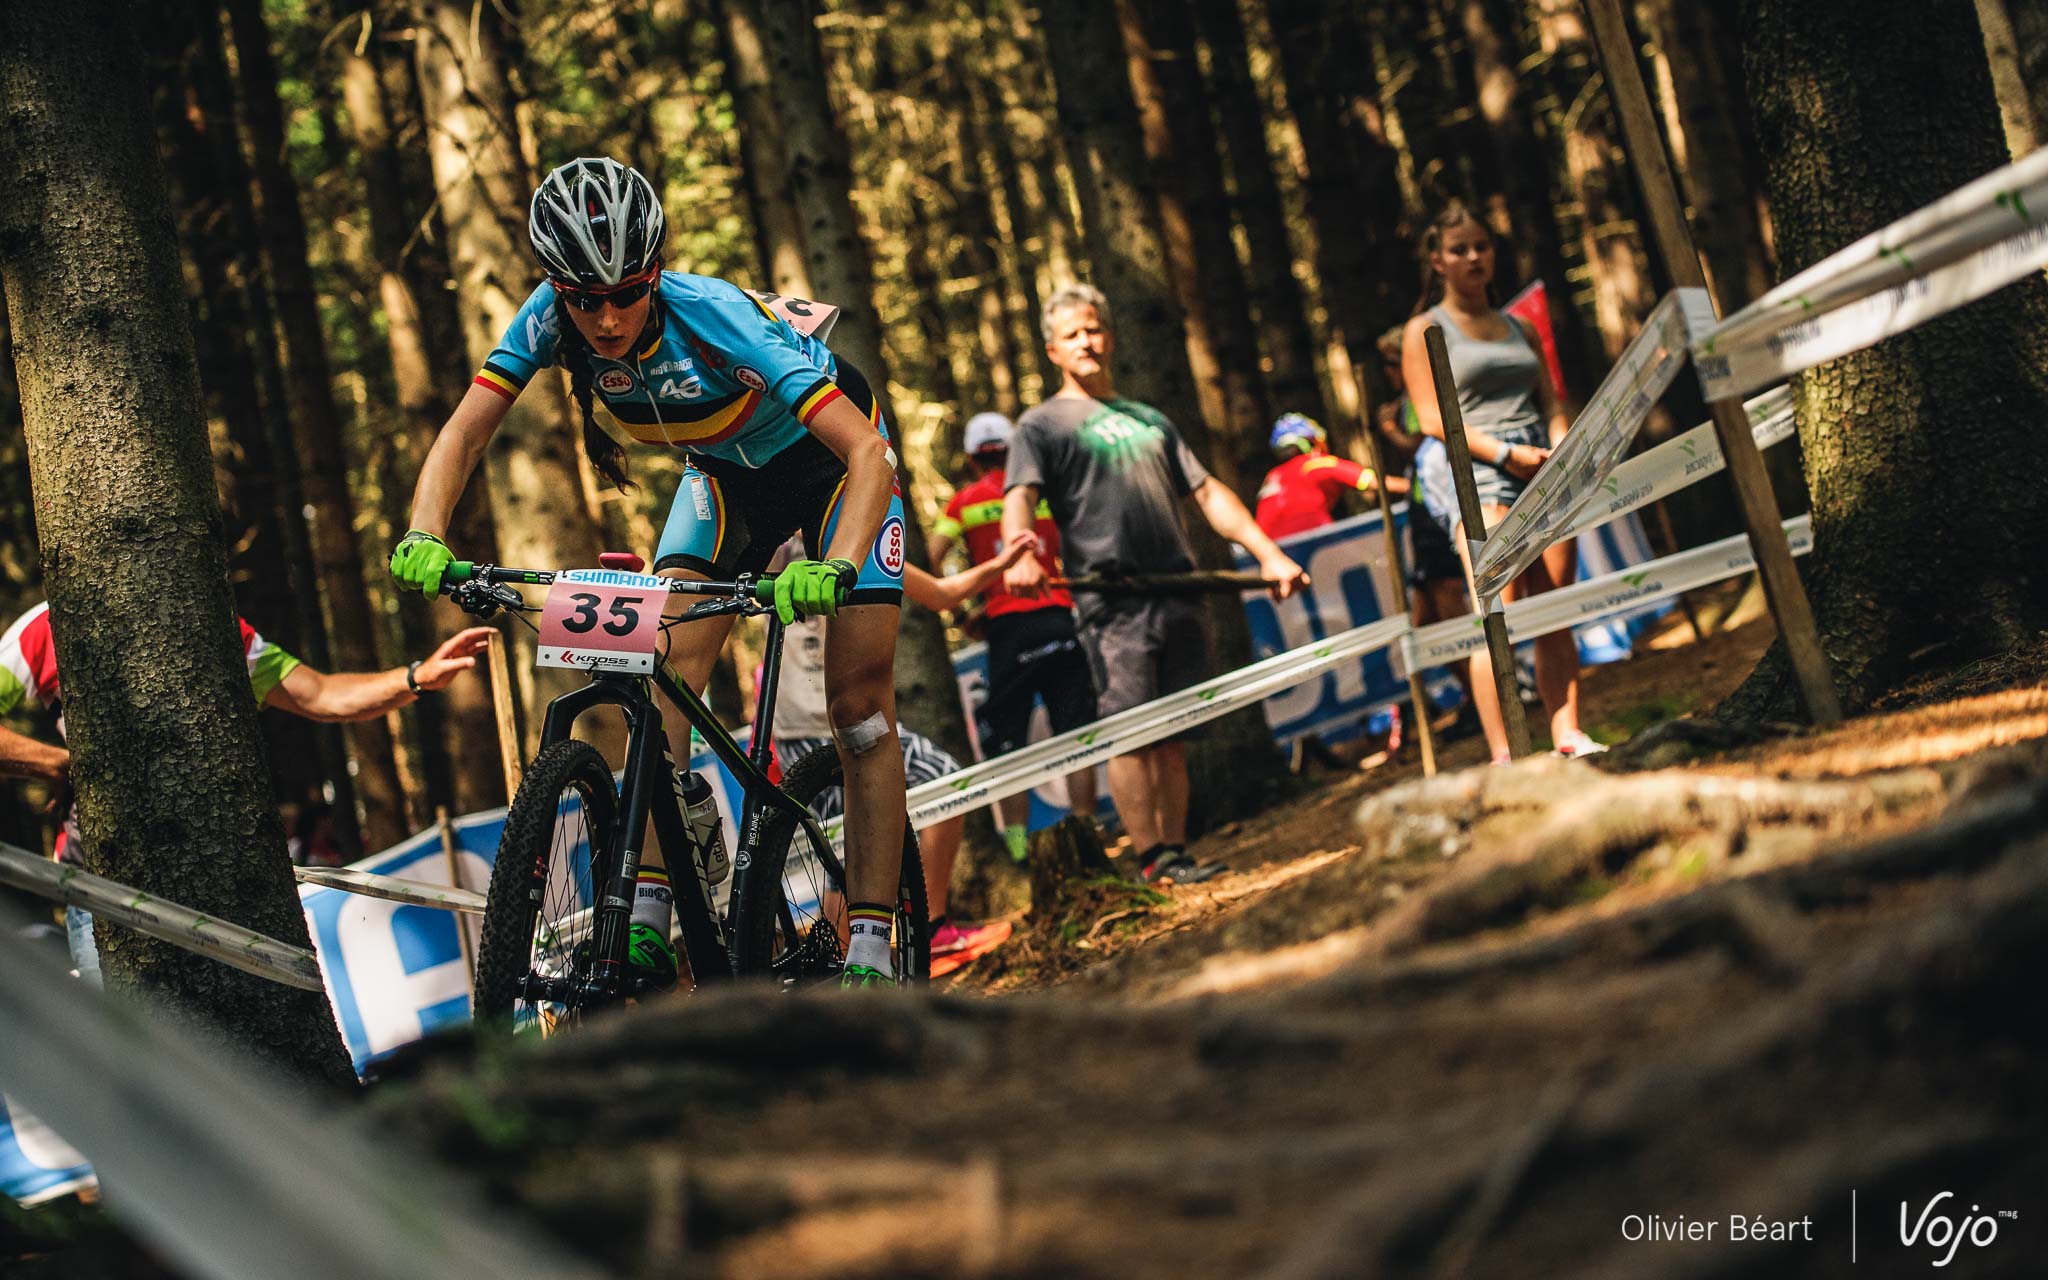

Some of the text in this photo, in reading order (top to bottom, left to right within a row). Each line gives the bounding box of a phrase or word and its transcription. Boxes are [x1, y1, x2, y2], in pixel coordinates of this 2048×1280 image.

[570, 571, 657, 588] SHIMANO
[561, 593, 643, 636] 35
[576, 655, 629, 665] KROSS
